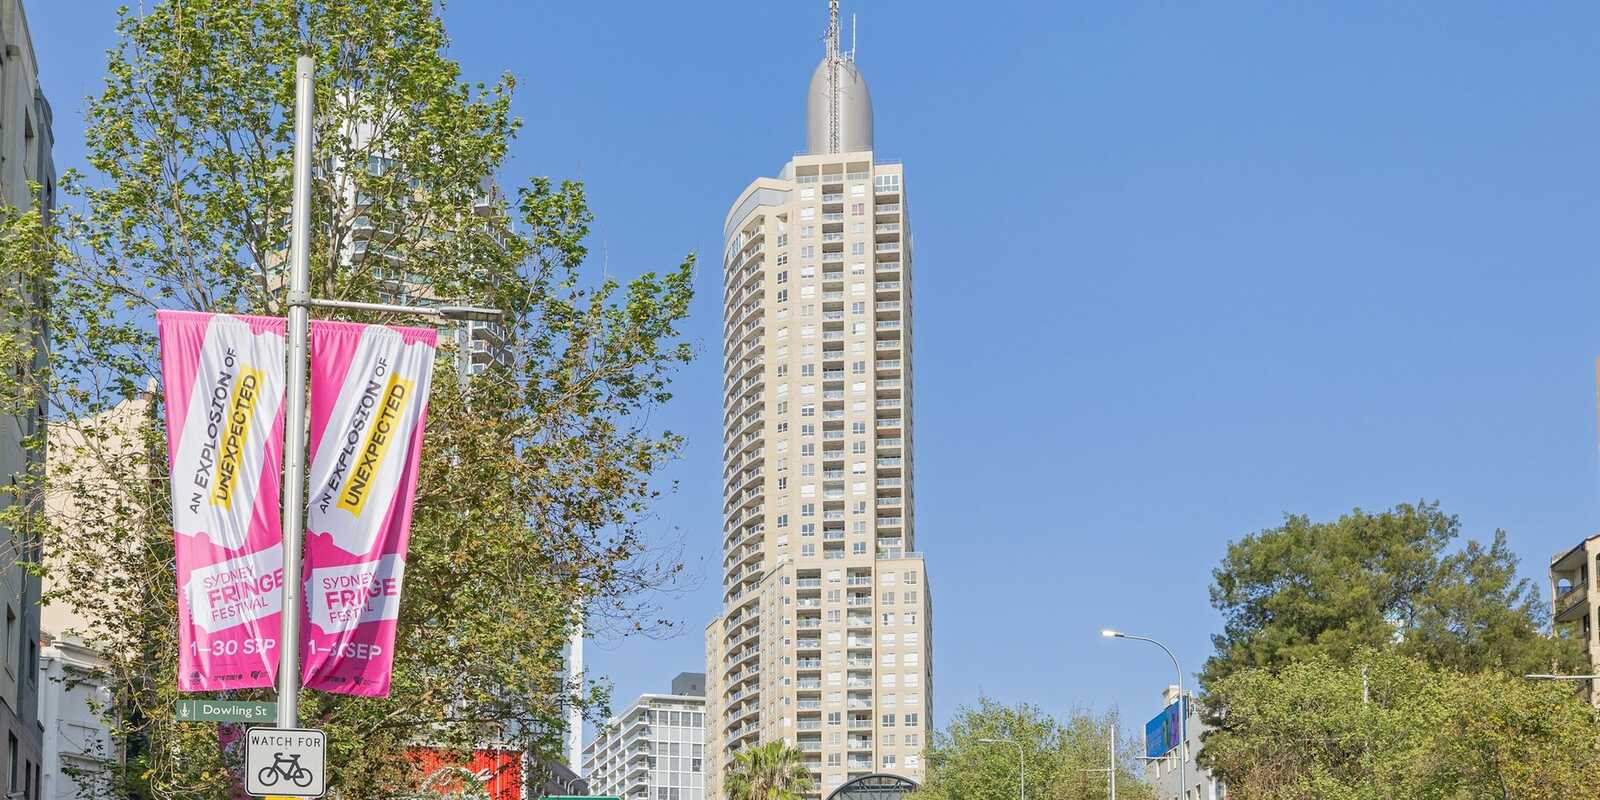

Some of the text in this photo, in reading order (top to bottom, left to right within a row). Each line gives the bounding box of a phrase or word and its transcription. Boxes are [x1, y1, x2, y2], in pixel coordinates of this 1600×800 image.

[189, 347, 237, 514] AN EXPLOSION OF
[216, 374, 257, 501] UNEXPECTED
[319, 357, 388, 514] AN EXPLOSION OF
[345, 384, 405, 507] UNEXPECTED
[203, 565, 254, 588] SYDNEY
[207, 568, 283, 609] FRINGE
[322, 571, 377, 590] SYDNEY
[211, 596, 269, 621] FESTIVAL
[345, 642, 382, 661] SEP
[203, 704, 267, 718] Dowling St
[251, 735, 321, 748] WATCH FOR
